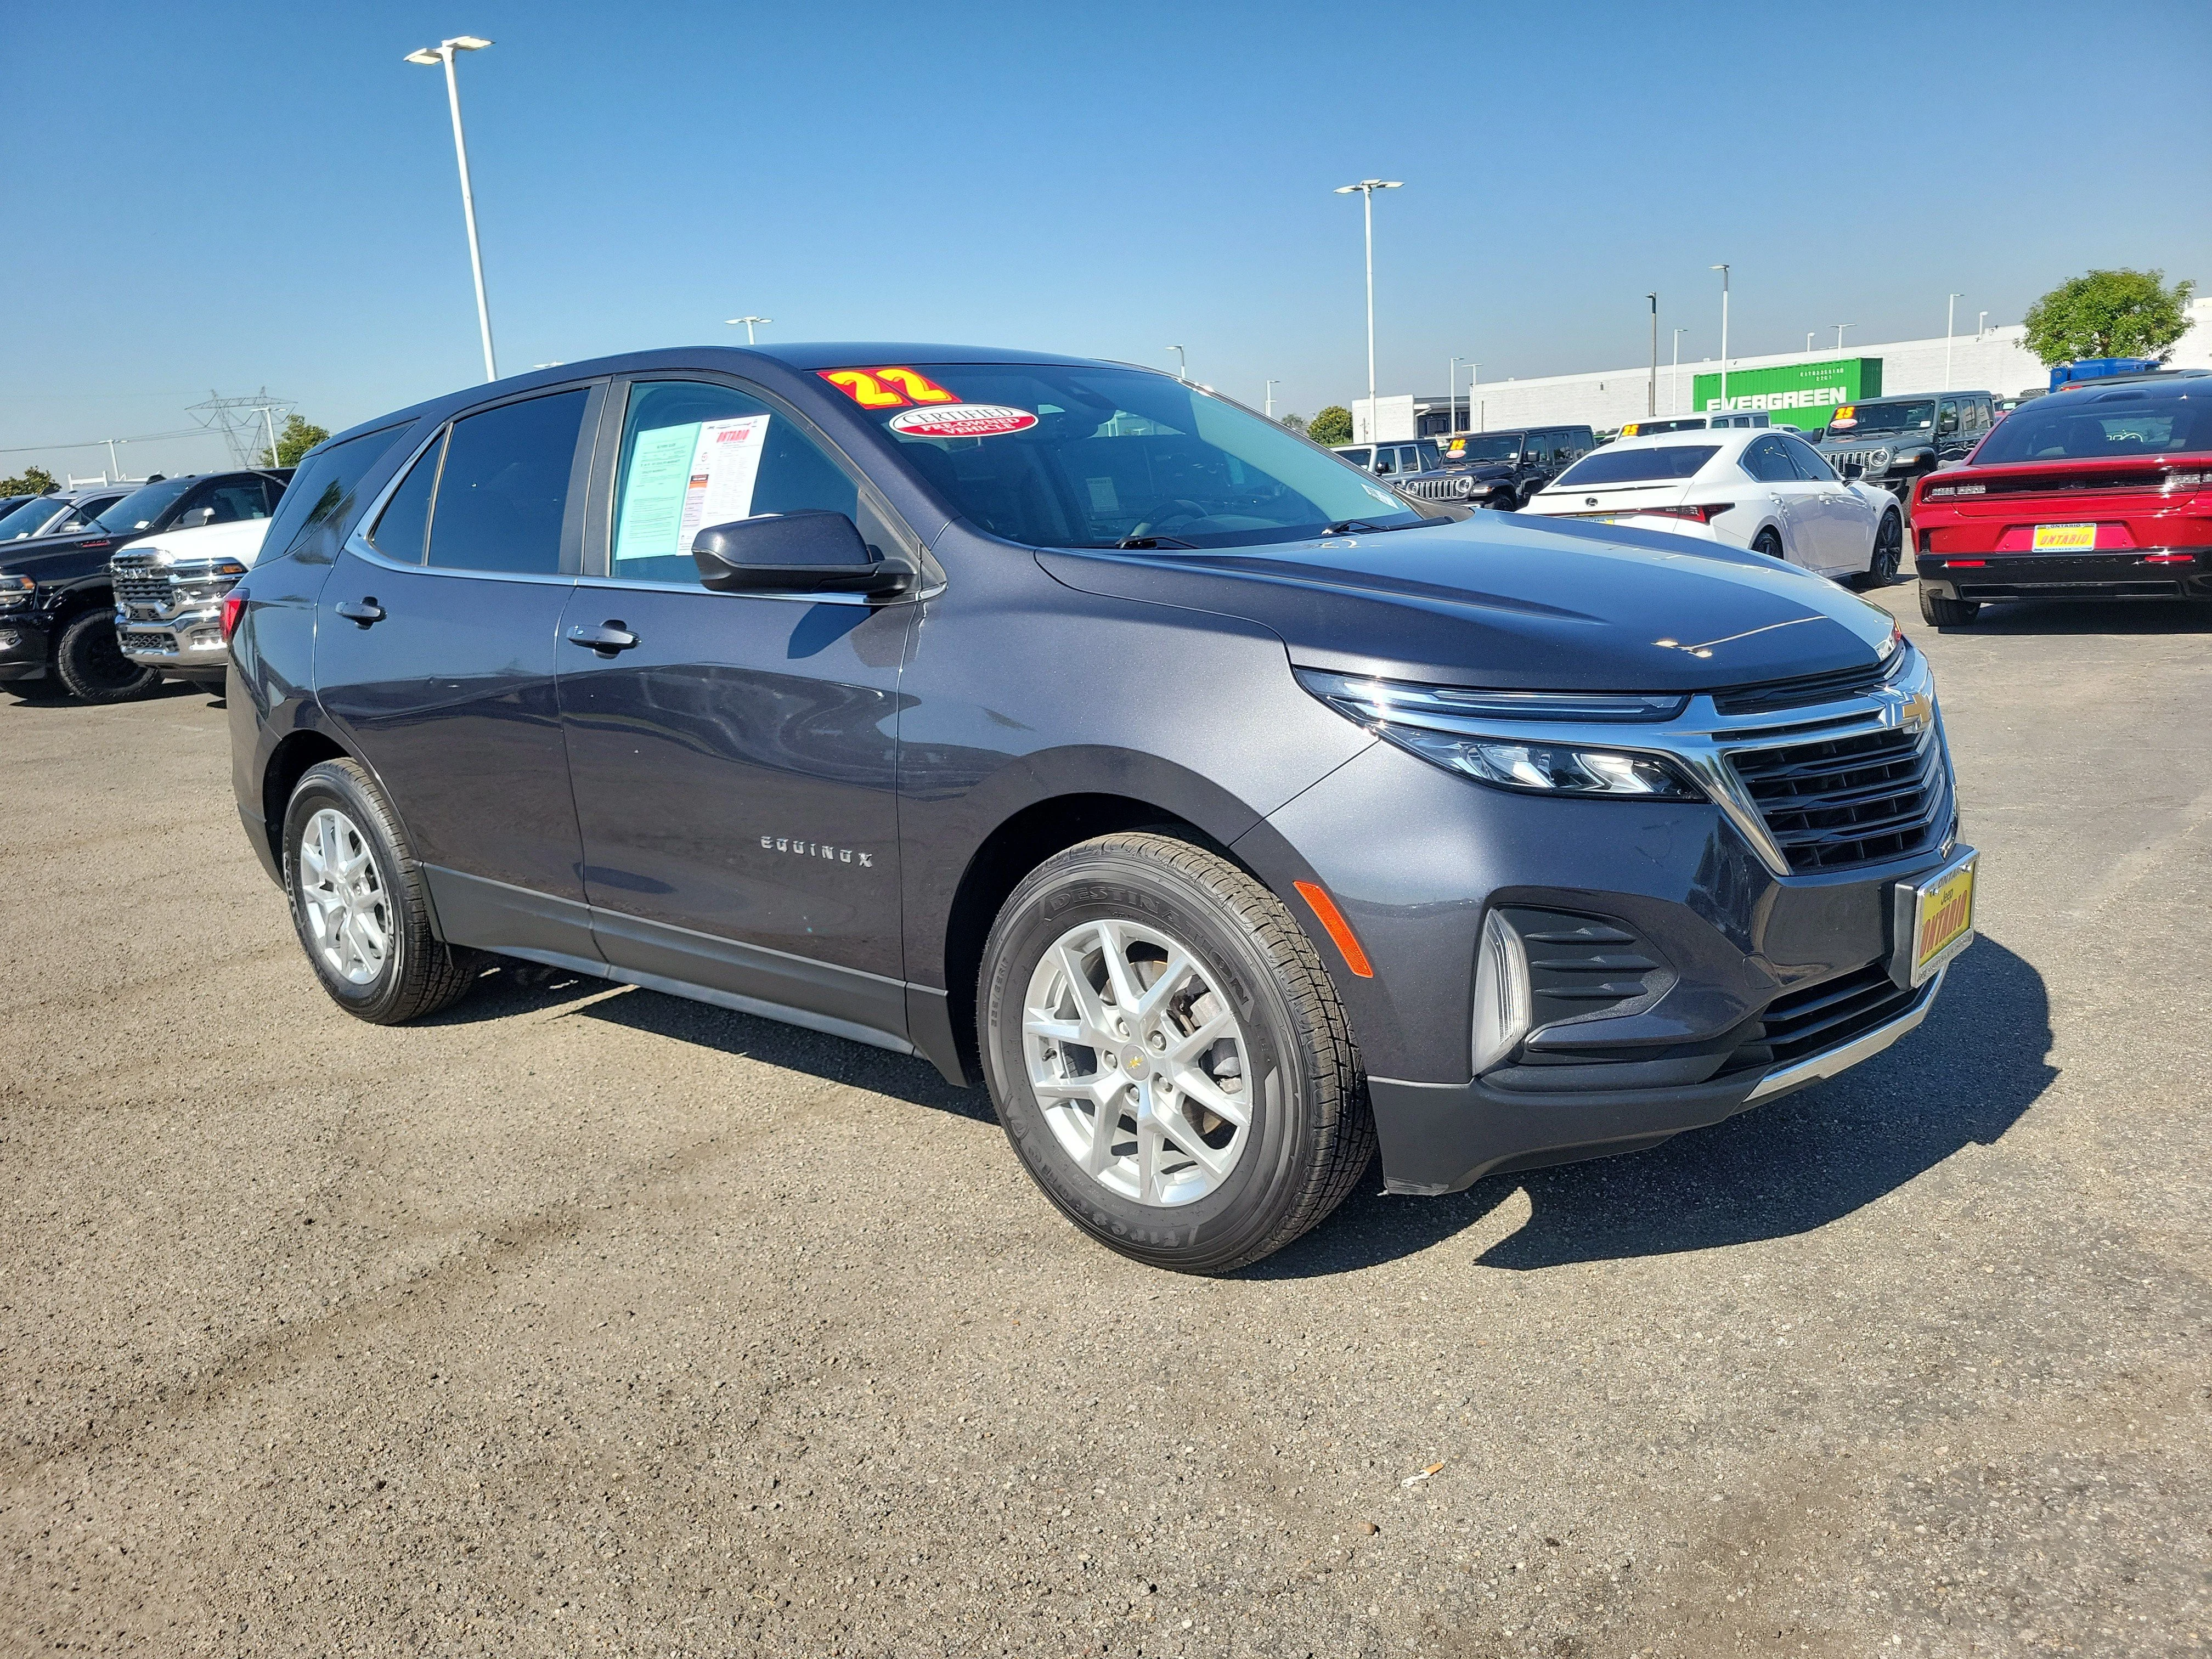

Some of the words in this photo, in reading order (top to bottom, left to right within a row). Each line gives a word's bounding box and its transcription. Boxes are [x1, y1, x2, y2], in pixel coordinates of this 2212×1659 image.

[827, 369, 952, 406] 22
[1706, 386, 1847, 411] EVERGREEN
[902, 408, 1013, 425] CERTIFIED
[1836, 407, 1854, 420] 25
[919, 417, 1021, 431] PRE-OWNED
[943, 423, 1016, 435] VEHICLE
[1622, 425, 1639, 436] 25
[2040, 534, 2090, 545] ONTARIO
[761, 836, 873, 867] EQUINOX
[1940, 888, 1954, 905] Jeep
[1920, 889, 1967, 959] ONTARIO
[1049, 885, 1250, 1006] DESTINATION
